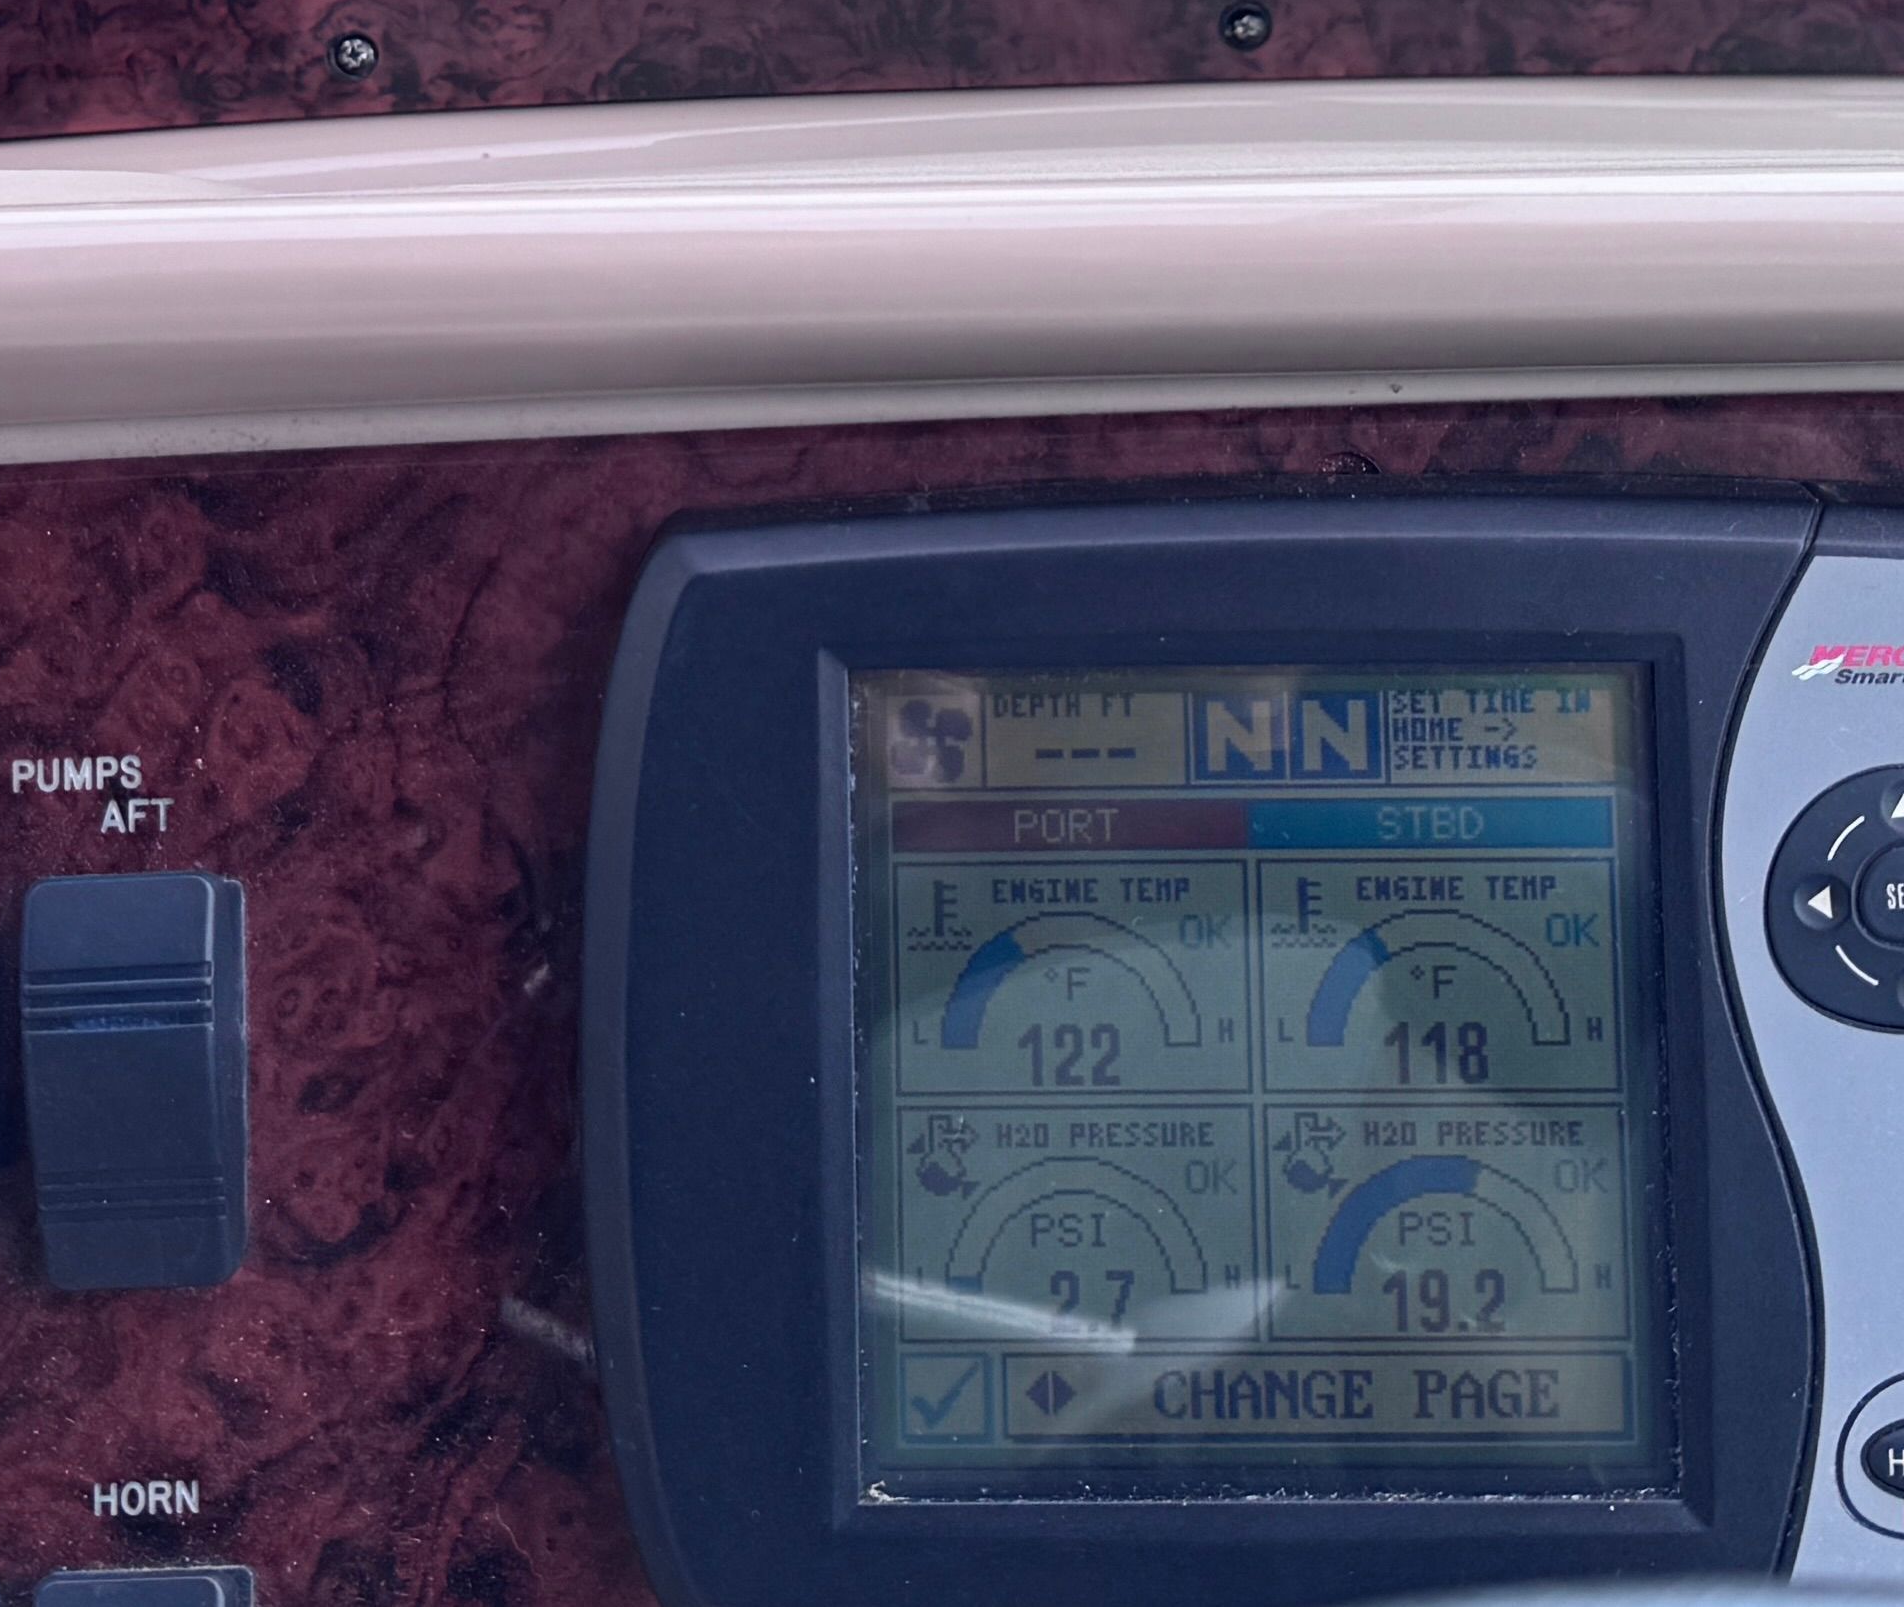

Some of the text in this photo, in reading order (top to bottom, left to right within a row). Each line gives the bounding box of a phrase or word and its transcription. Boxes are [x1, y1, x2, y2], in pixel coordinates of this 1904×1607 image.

[992, 692, 1136, 718] DEPTH FT
[1390, 690, 1592, 714] SET TIME IN
[1206, 700, 1272, 772] N
[1301, 699, 1369, 772] N
[1391, 717, 1465, 743] HOME
[12, 755, 143, 794] PUMPS
[1393, 744, 1539, 771] SETTINGS
[101, 798, 174, 834] AFT
[1013, 808, 1120, 844] PORT
[1377, 806, 1485, 840] STBD
[992, 877, 1191, 905] ENGINE TEMP
[1356, 875, 1557, 901] ENGINE TEMP
[1179, 914, 1233, 949] OK
[1546, 913, 1600, 947] OK
[912, 1020, 929, 1046] L
[1218, 1017, 1235, 1043] H
[1278, 1017, 1294, 1043] L
[1586, 1016, 1603, 1042] H
[1017, 1023, 1122, 1087] 122
[1384, 1021, 1490, 1085] 118
[996, 1122, 1215, 1149] H2O PRESSURE
[1363, 1120, 1584, 1146] H2O PRESSURE
[1185, 1159, 1238, 1194] OK
[1554, 1158, 1609, 1193] OK
[1031, 1213, 1107, 1248] PSI
[1399, 1212, 1476, 1246] PSI
[1224, 1264, 1241, 1289] H
[1284, 1264, 1301, 1290] L
[1382, 1269, 1507, 1333] 19.2
[1154, 1370, 1561, 1420] CHANGE PAGE
[92, 1480, 201, 1518] HORN
